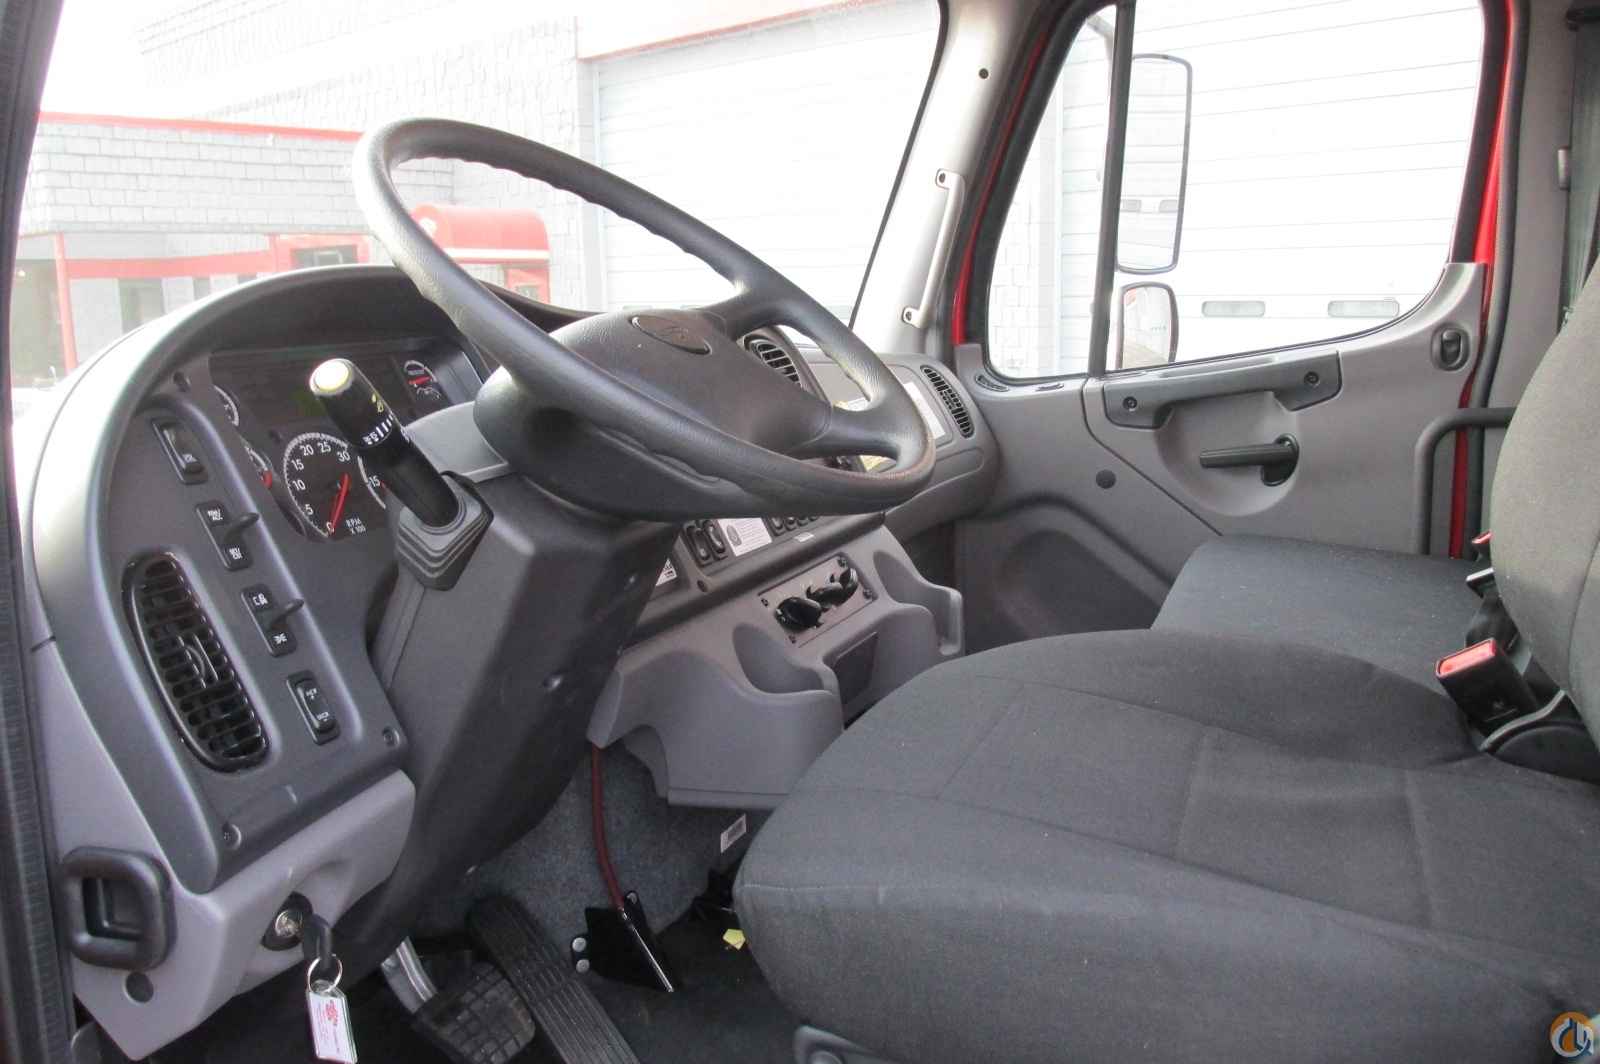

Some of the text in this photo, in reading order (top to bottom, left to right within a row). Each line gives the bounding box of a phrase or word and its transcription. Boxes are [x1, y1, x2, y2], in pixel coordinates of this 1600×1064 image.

[300, 444, 314, 456] 20
[317, 441, 331, 454] 25
[337, 450, 350, 462] 30
[291, 459, 304, 471] 15
[292, 479, 306, 491] 10
[369, 475, 381, 488] 15
[304, 503, 314, 515] 5
